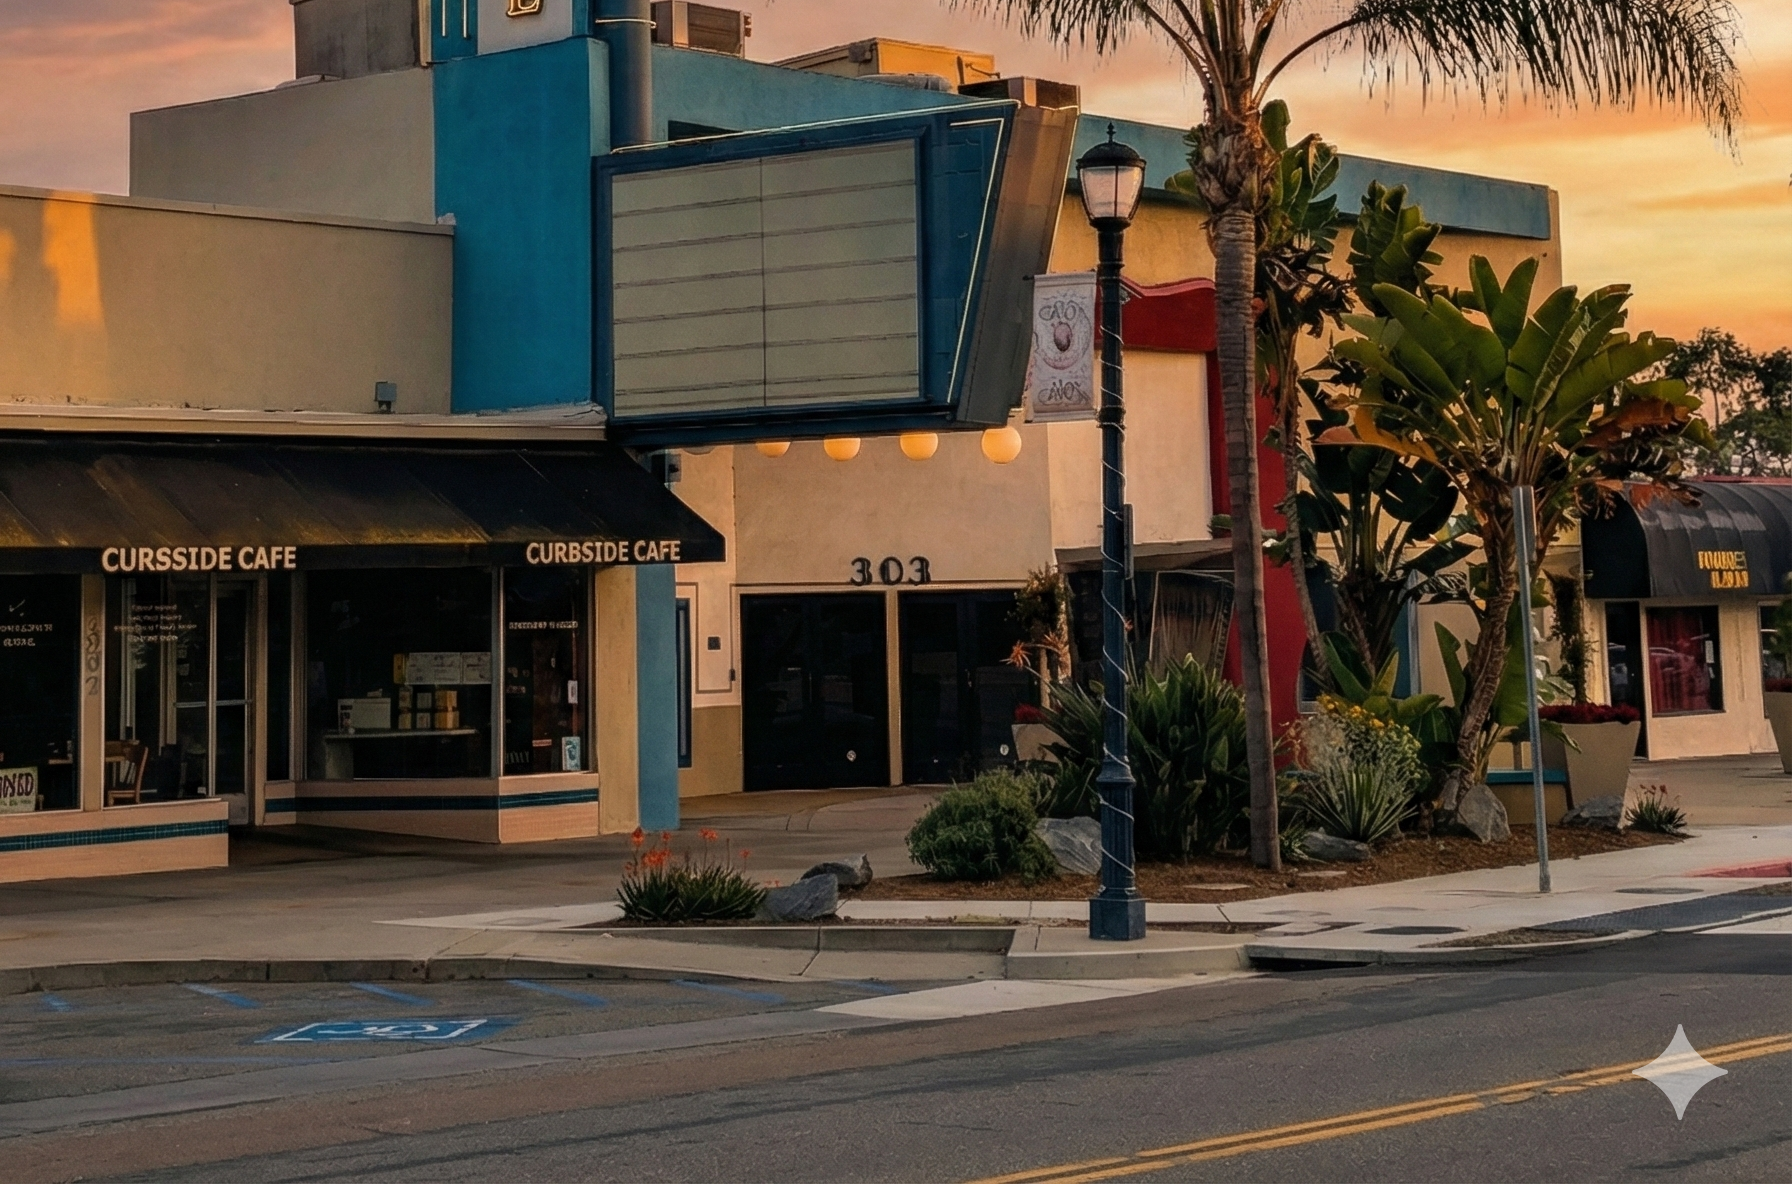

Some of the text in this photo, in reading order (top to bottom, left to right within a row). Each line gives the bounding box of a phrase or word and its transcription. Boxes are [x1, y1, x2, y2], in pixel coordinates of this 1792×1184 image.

[101, 545, 297, 572] CURSSIDE CAFE
[525, 539, 681, 565] CURBSIDE CAFE
[849, 556, 932, 587] 303
